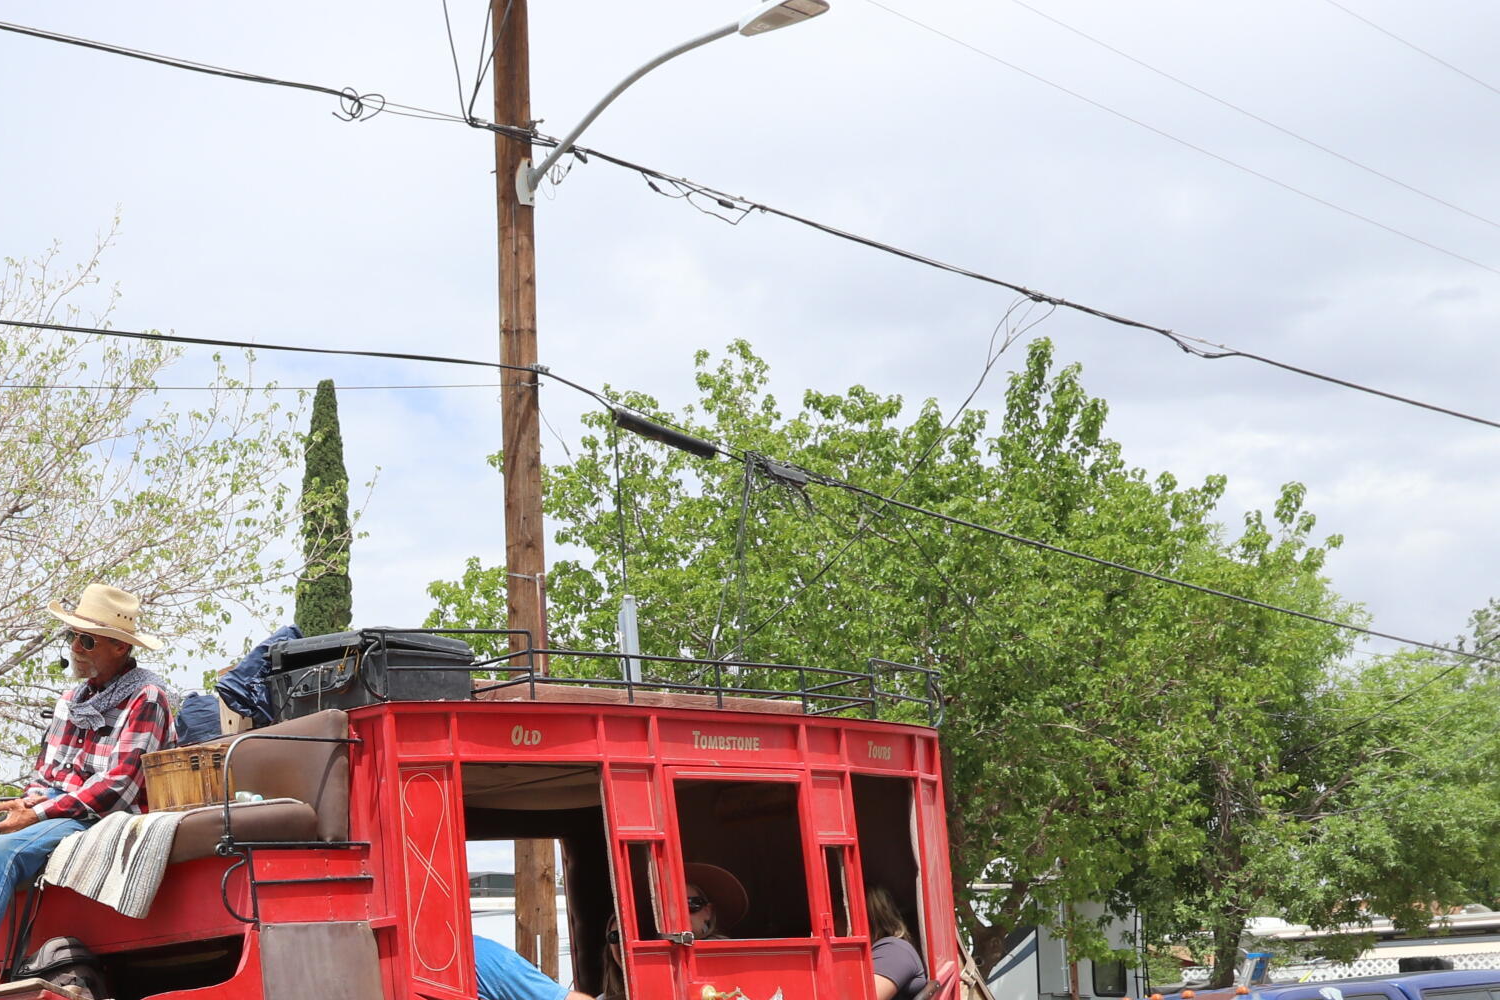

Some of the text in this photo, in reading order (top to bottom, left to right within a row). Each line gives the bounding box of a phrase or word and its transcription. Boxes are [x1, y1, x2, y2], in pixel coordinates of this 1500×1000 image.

[511, 724, 893, 761] OLD TOMBSTONE TOURS
